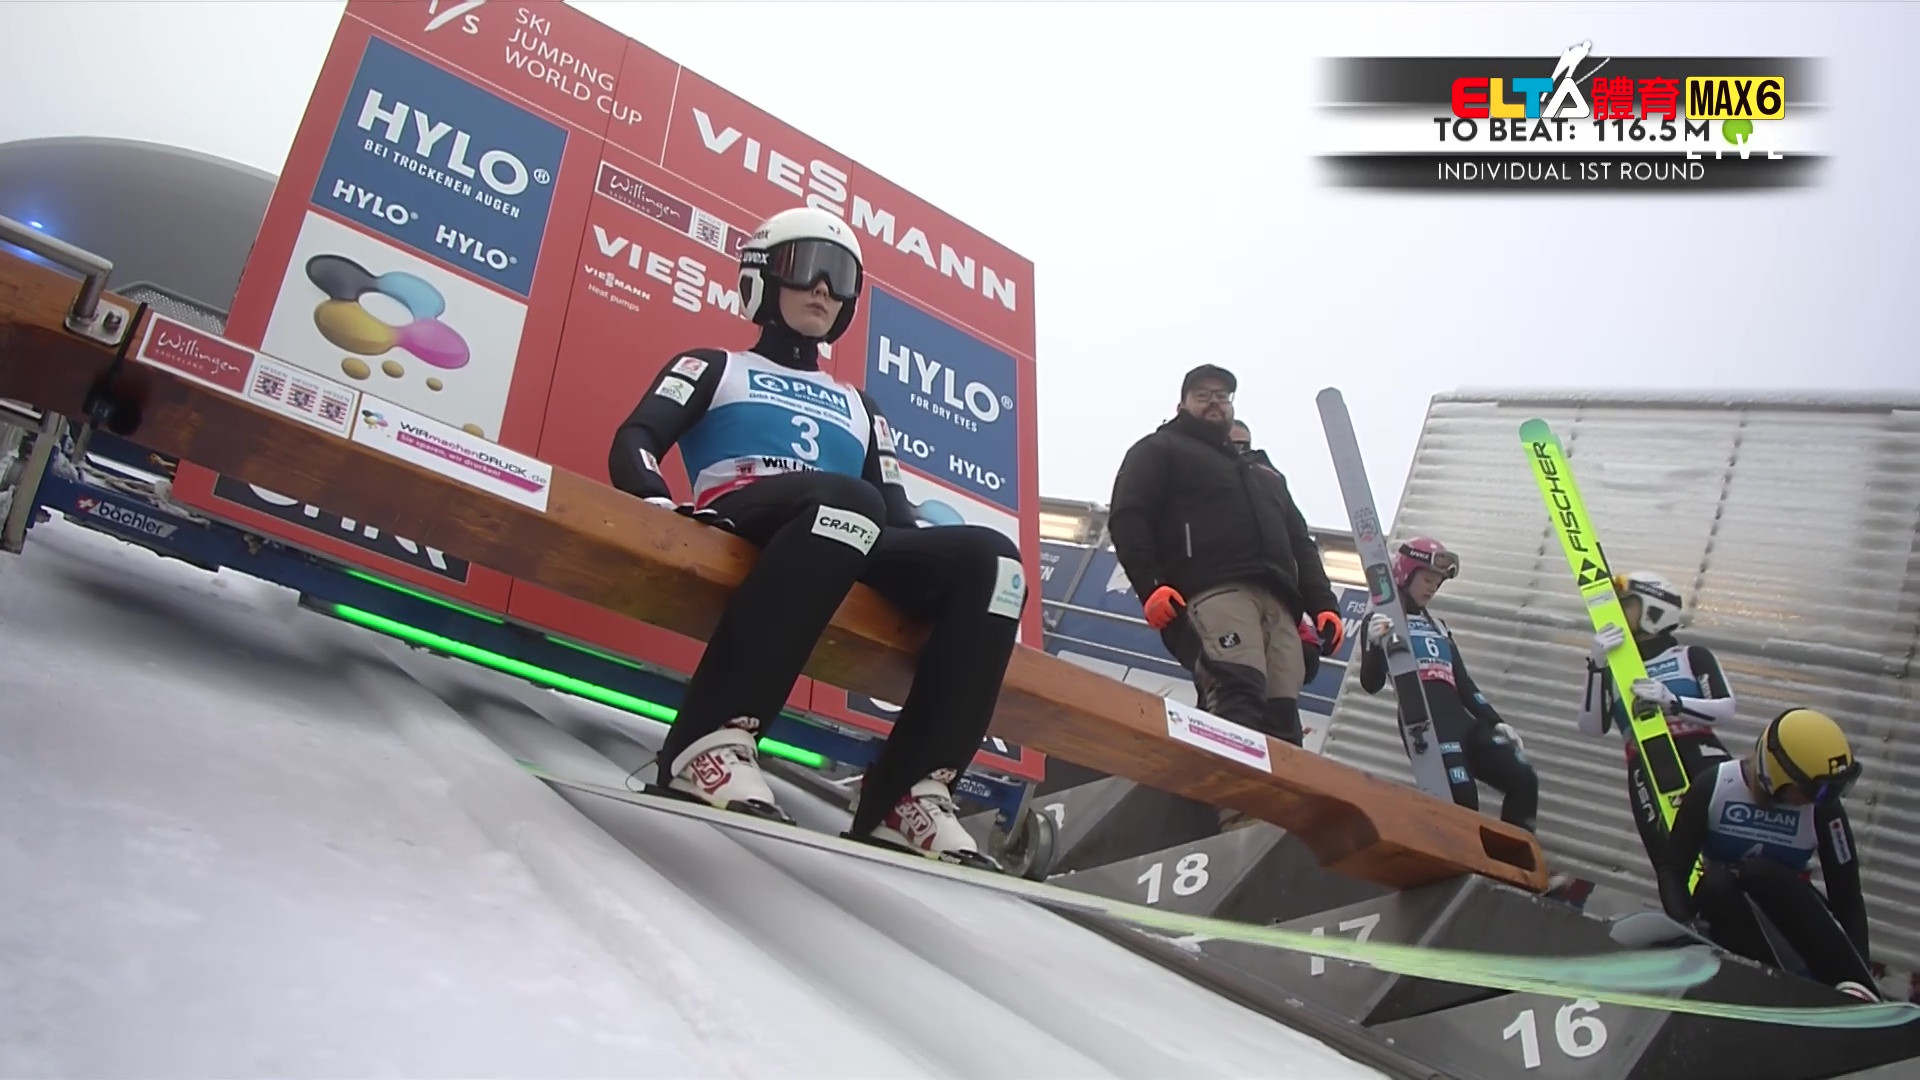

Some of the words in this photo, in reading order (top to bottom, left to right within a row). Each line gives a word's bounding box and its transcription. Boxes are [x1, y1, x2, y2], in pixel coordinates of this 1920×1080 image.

[514, 7, 552, 36] SKI
[508, 29, 614, 92] JUMPING
[504, 50, 591, 101] WORLD
[596, 97, 643, 127] CUP
[364, 139, 388, 158] BEI
[393, 151, 471, 197] TROCKENEN
[475, 191, 521, 219] AUGEN
[610, 175, 681, 218] Willingen
[588, 283, 609, 299] Heat
[609, 293, 640, 312] pumps
[157, 331, 241, 374] Willingen
[792, 381, 847, 409] PLAN
[910, 393, 929, 410] FOR
[932, 404, 950, 421] DRY
[954, 414, 978, 432] EYES
[791, 414, 820, 461] 3
[890, 427, 930, 458] YLO
[1532, 441, 1589, 553] FISCHER
[819, 516, 867, 539] CRAFT
[1425, 637, 1439, 658] 6
[1753, 809, 1797, 827] PLAN
[1136, 852, 1210, 905] 18
[1310, 912, 1381, 976] 17
[1503, 998, 1608, 1069] 16
